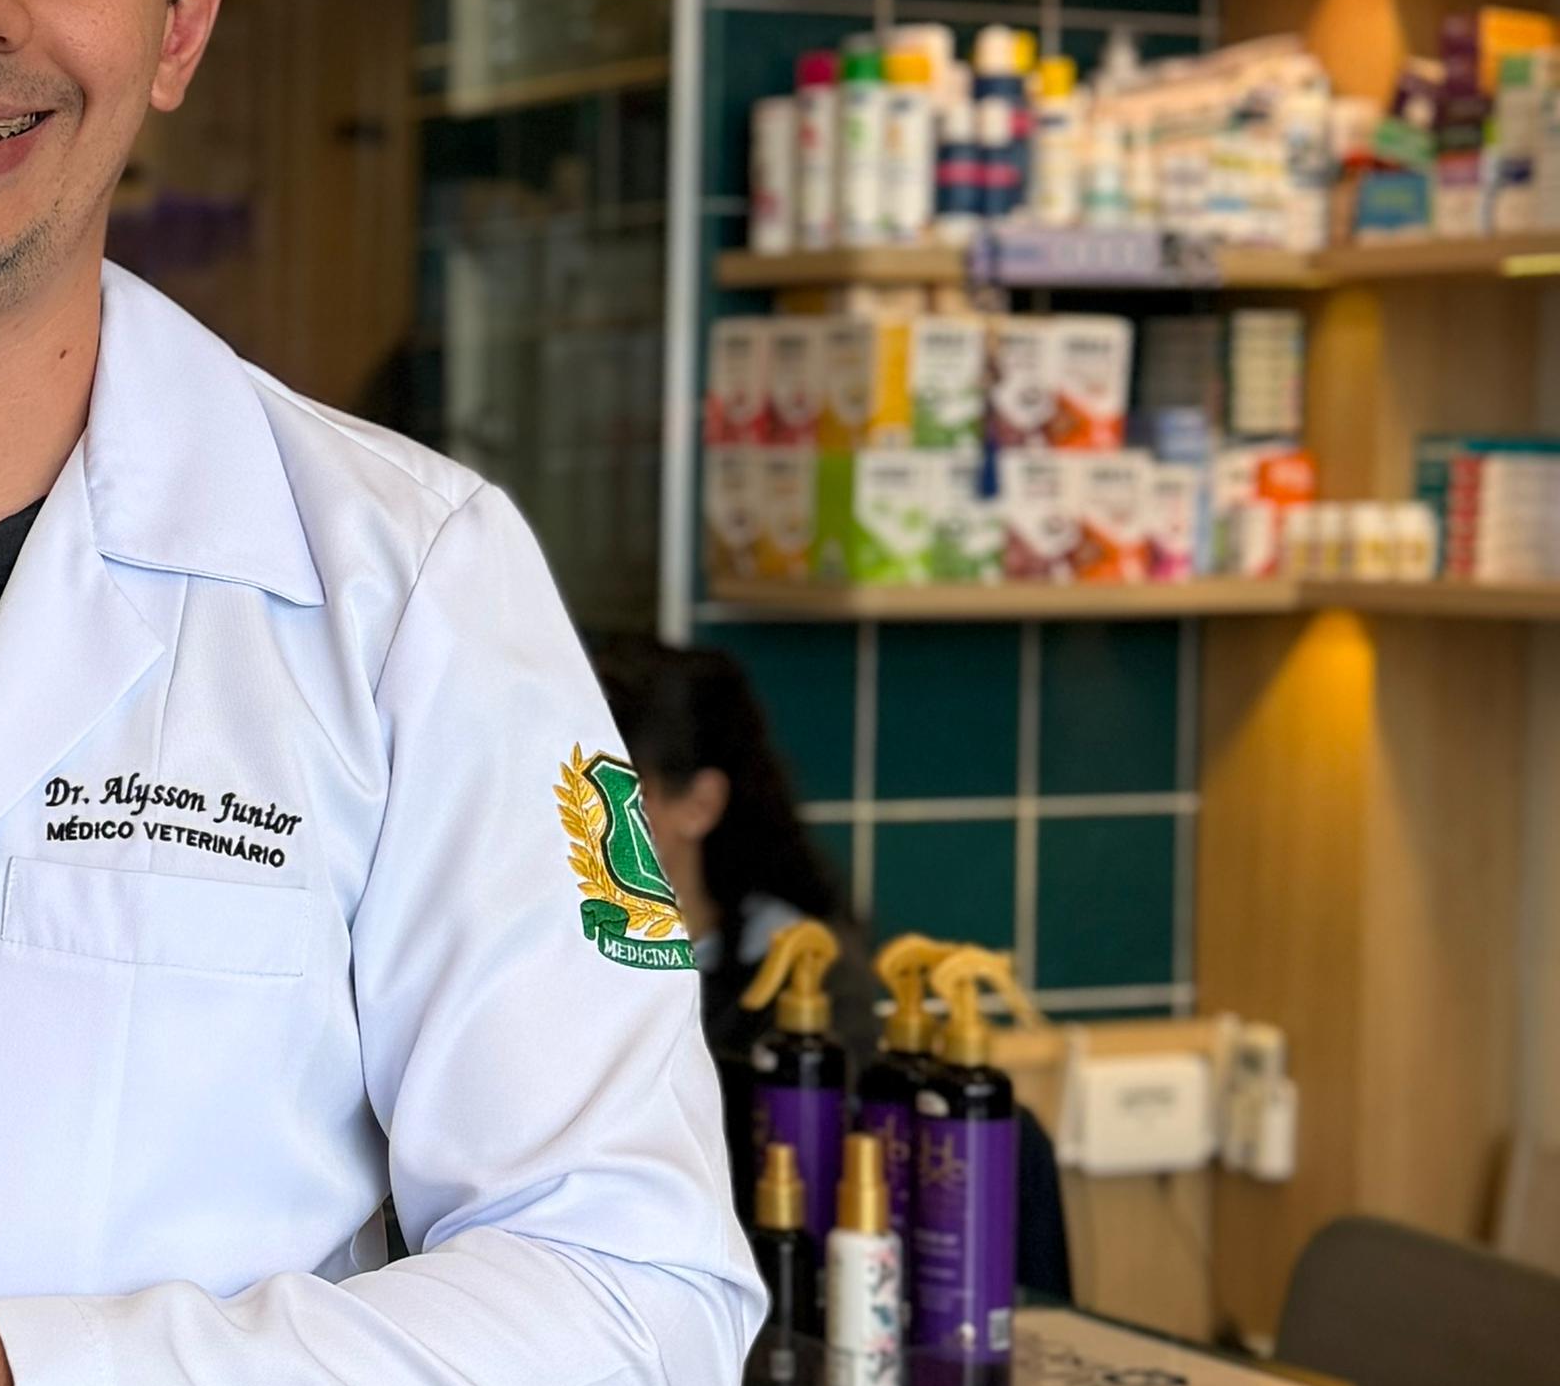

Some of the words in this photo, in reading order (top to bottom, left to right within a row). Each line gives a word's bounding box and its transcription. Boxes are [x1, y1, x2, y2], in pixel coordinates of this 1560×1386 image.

[45, 776, 90, 808] Dr.
[100, 773, 207, 816] Alysson
[213, 792, 303, 837] Junior
[46, 816, 134, 841] MÉDICO
[143, 821, 286, 869] VETERINÁRIO
[603, 937, 684, 966] MEDICINA
